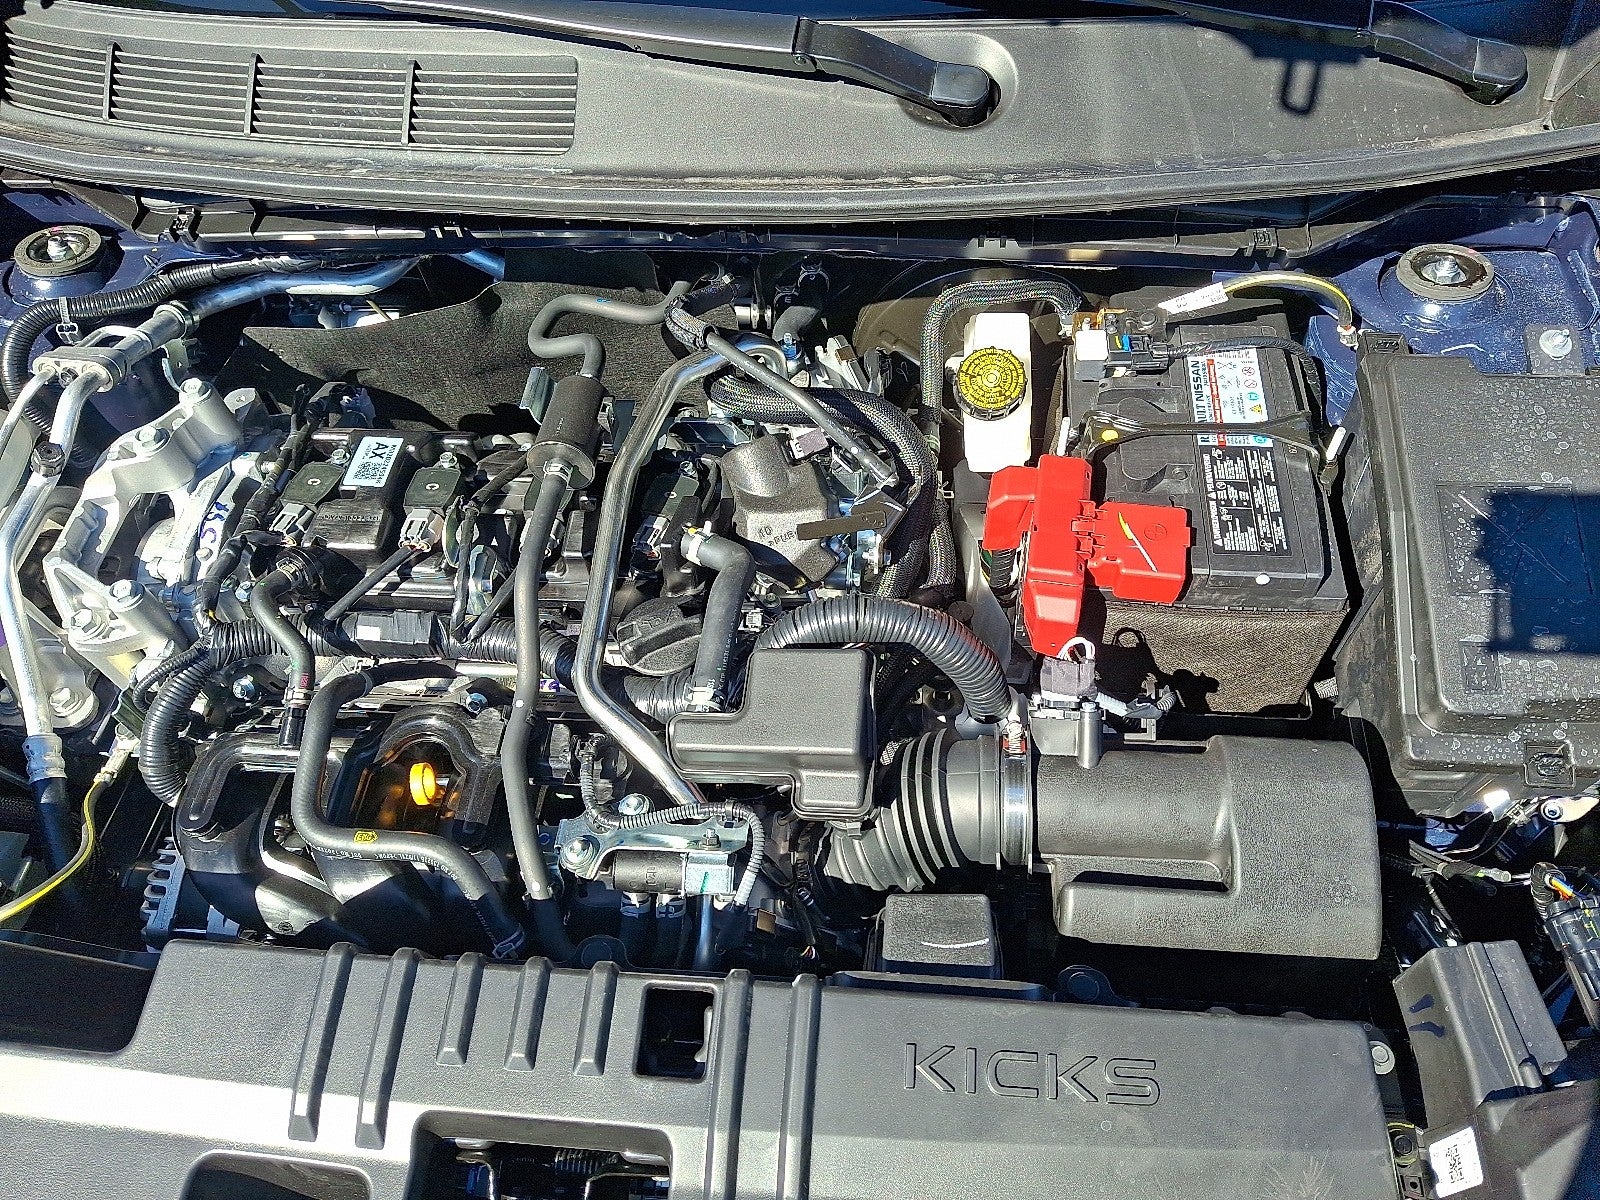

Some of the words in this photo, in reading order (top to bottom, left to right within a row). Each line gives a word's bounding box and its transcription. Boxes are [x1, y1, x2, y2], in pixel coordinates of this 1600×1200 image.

[1191, 360, 1203, 401] NISSAN
[371, 442, 390, 459] AX
[903, 1042, 1161, 1107] KICKS
